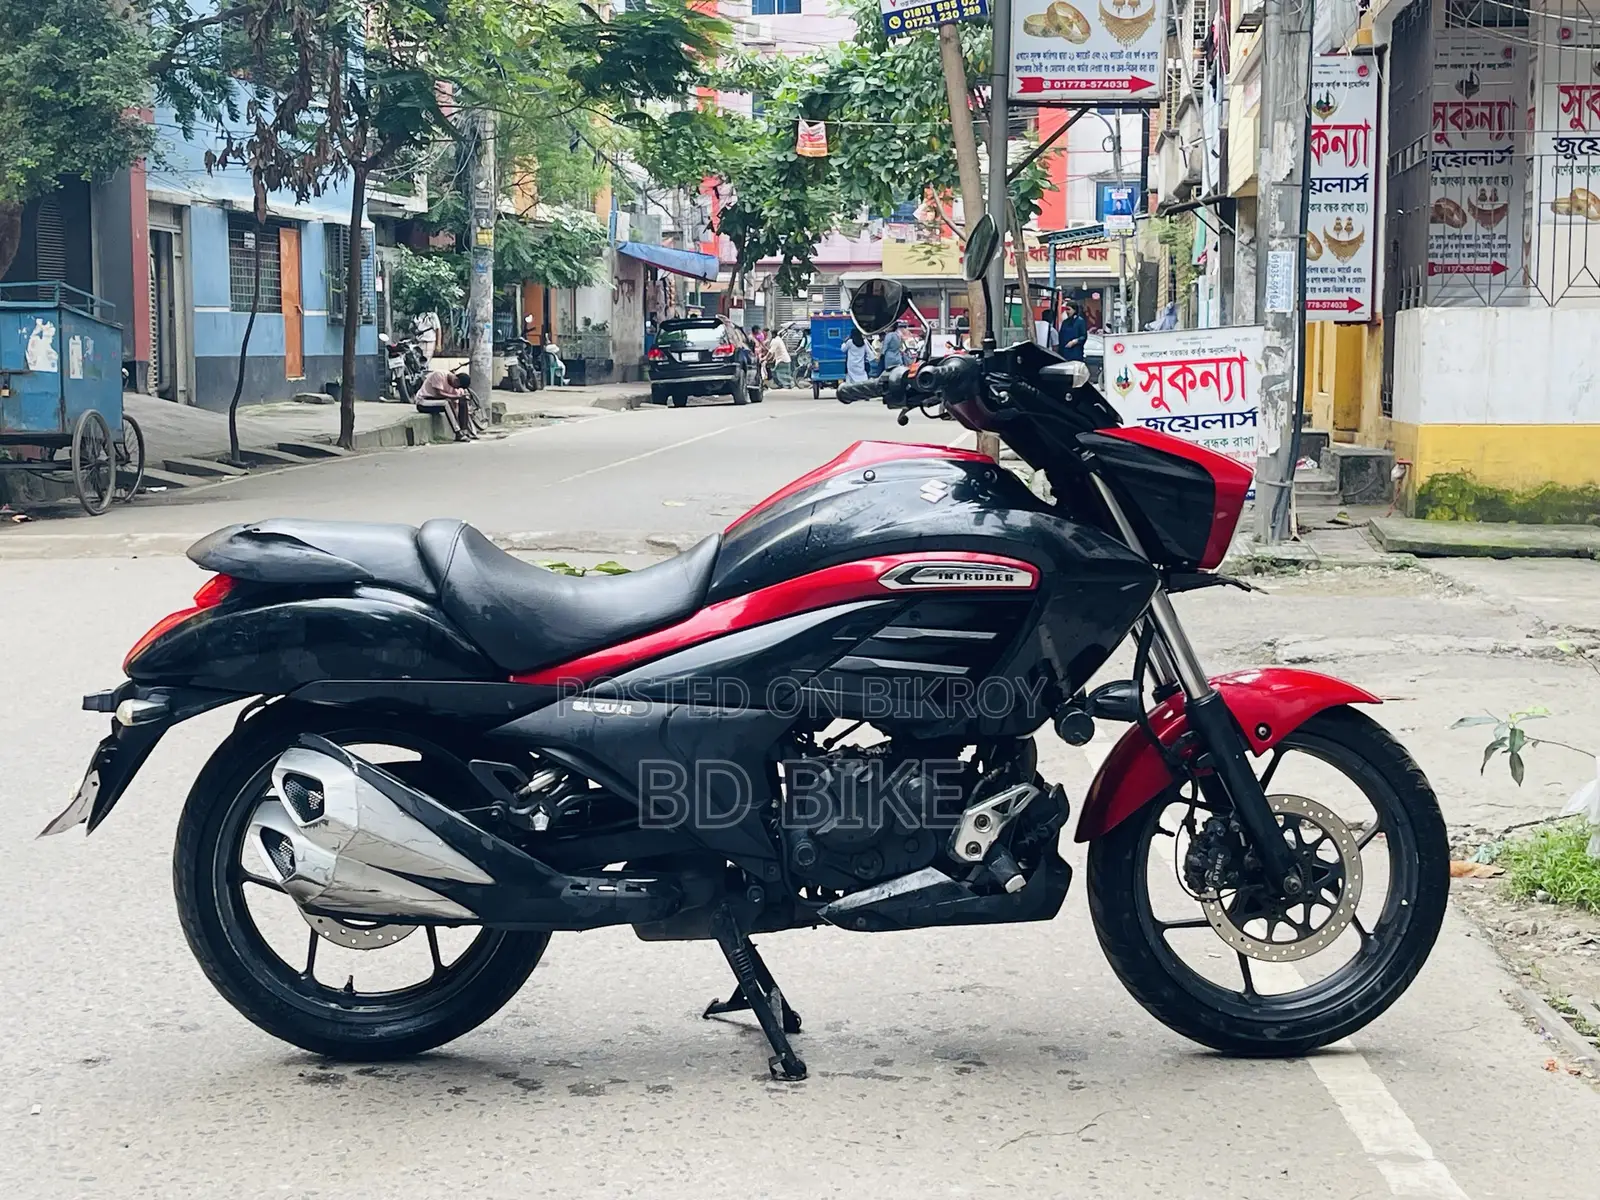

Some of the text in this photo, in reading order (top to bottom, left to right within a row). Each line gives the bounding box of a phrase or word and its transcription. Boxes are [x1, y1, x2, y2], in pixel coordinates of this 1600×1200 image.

[1310, 118, 1372, 168] কন্যা
[1134, 350, 1249, 413] সুকন্যা
[1137, 406, 1259, 432] জয়েলার্স
[1232, 436, 1254, 448] রাখা
[938, 572, 1014, 582] INTRUDER
[572, 700, 632, 715] SUZUKI
